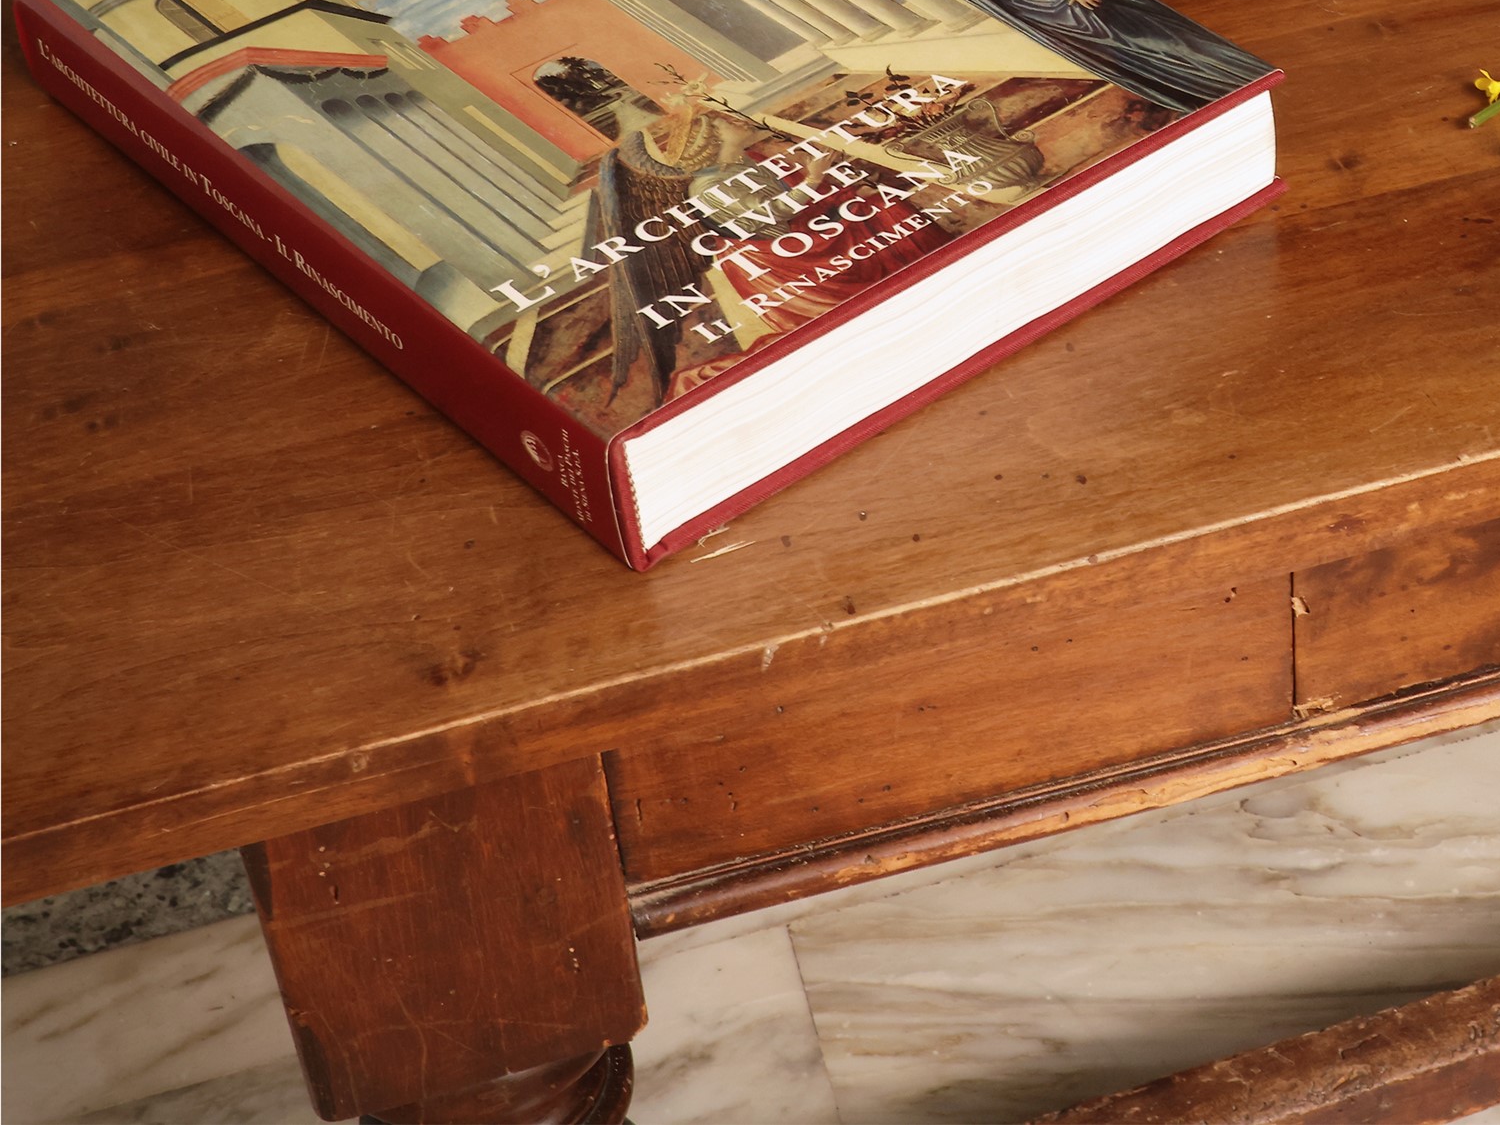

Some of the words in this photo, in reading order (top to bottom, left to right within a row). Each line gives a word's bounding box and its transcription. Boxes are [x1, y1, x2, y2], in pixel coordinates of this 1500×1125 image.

[140, 130, 181, 172] CIVILE
[183, 163, 198, 185] IN
[200, 173, 265, 240] TOSCANA
[293, 249, 404, 350] RINASCIMENTO
[489, 74, 968, 312] L'ARCHITETTURA
[636, 283, 712, 329] IN
[712, 149, 982, 282] TOSCANA
[690, 319, 742, 344] IL
[739, 180, 993, 317] RINASCIMENTO
[691, 161, 869, 257] CIVILE
